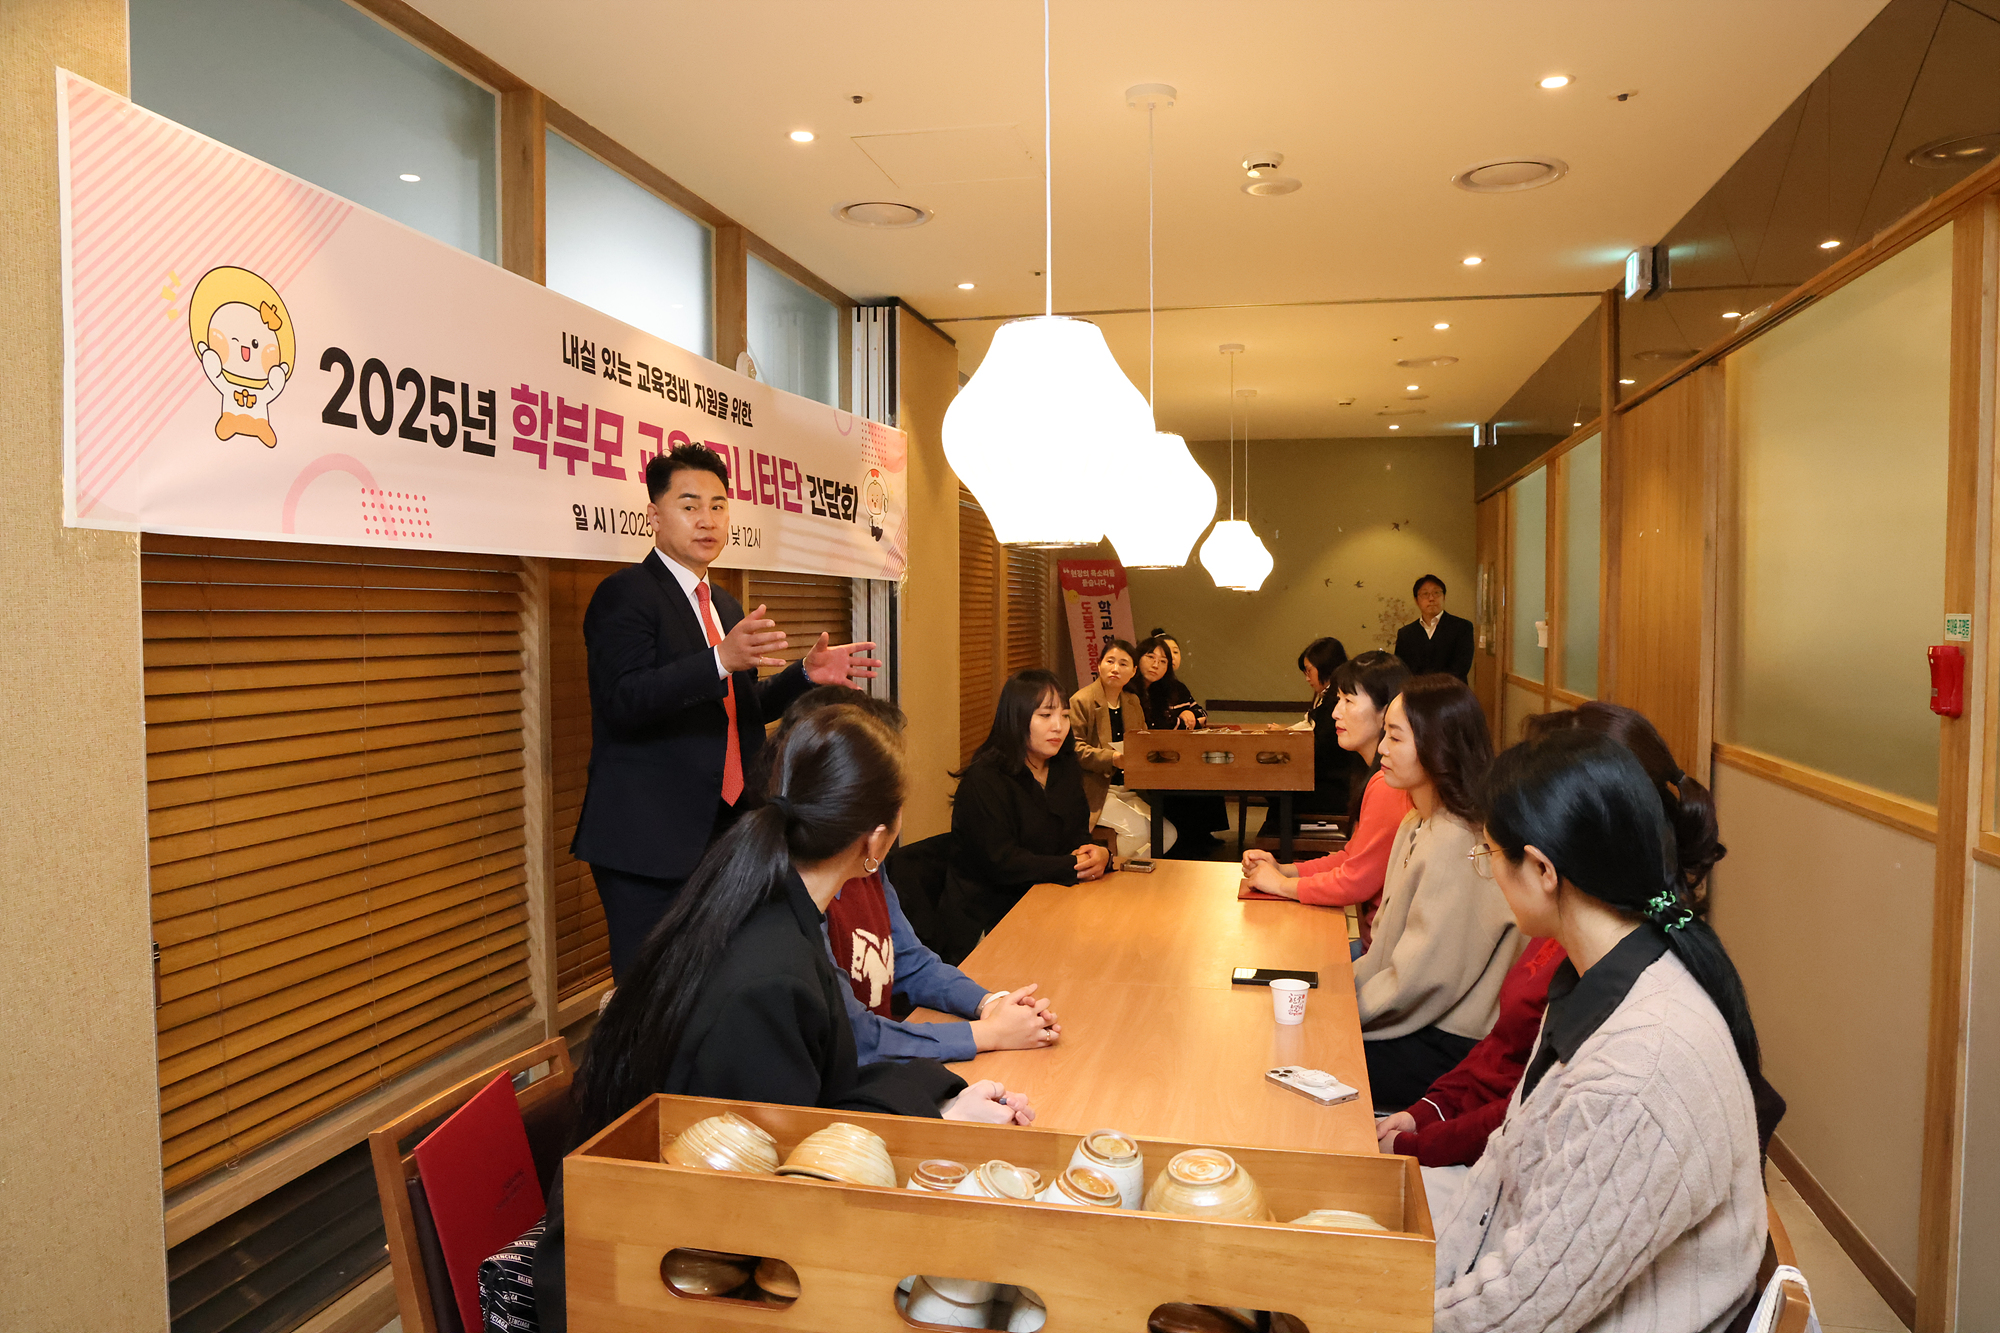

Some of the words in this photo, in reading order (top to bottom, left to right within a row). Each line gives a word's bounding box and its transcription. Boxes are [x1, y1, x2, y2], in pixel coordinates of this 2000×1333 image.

[562, 331, 596, 375] 내실
[601, 347, 632, 387] 있는
[636, 360, 691, 408] 교육경비
[693, 382, 729, 420] 지원을
[730, 396, 754, 428] 위한
[319, 346, 497, 458] 2025년
[510, 382, 628, 481] 학부모
[637, 420, 691, 485] 교
[805, 474, 859, 524] 간담회
[572, 503, 589, 531] 일
[593, 506, 607, 533] 시
[730, 524, 741, 547] 낮
[743, 526, 761, 549] 12시
[1097, 600, 1114, 630] 학교
